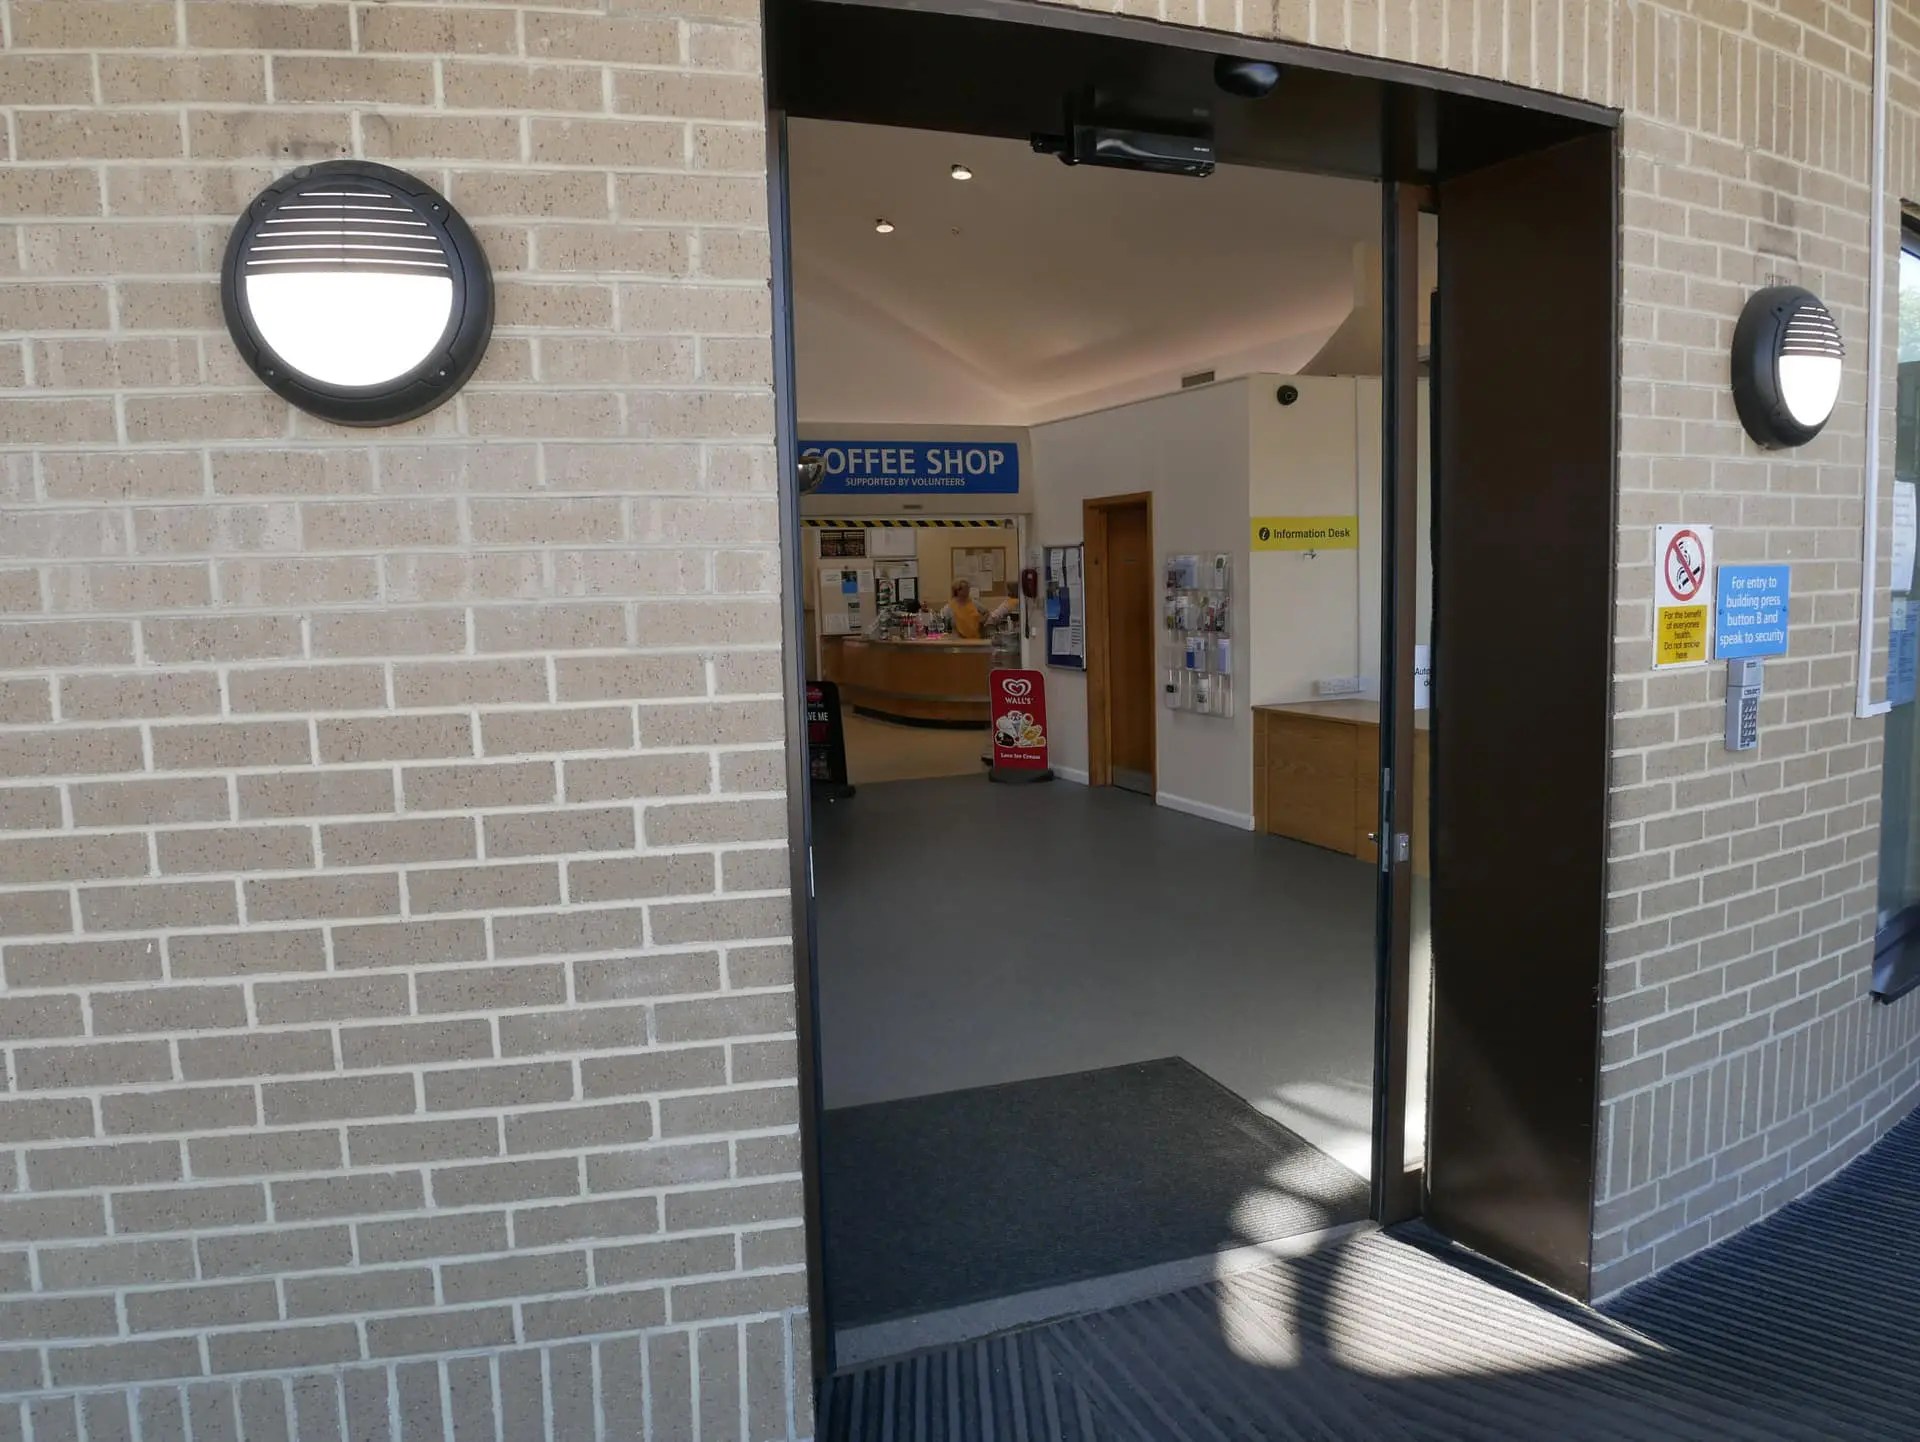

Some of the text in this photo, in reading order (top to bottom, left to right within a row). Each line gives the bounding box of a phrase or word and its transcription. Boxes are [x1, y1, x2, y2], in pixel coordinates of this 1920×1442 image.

[926, 448, 1005, 475] SHOP
[845, 477, 966, 487] SUPPORTED BY VOLUNTEERS
[1273, 528, 1351, 539] Information Desk
[1731, 575, 1777, 591] For entry to
[1726, 593, 1781, 610] building press
[1727, 610, 1778, 626] button B and
[1719, 629, 1785, 648] speak to security
[1004, 696, 1032, 705] WALL'S
[817, 711, 829, 721] ME
